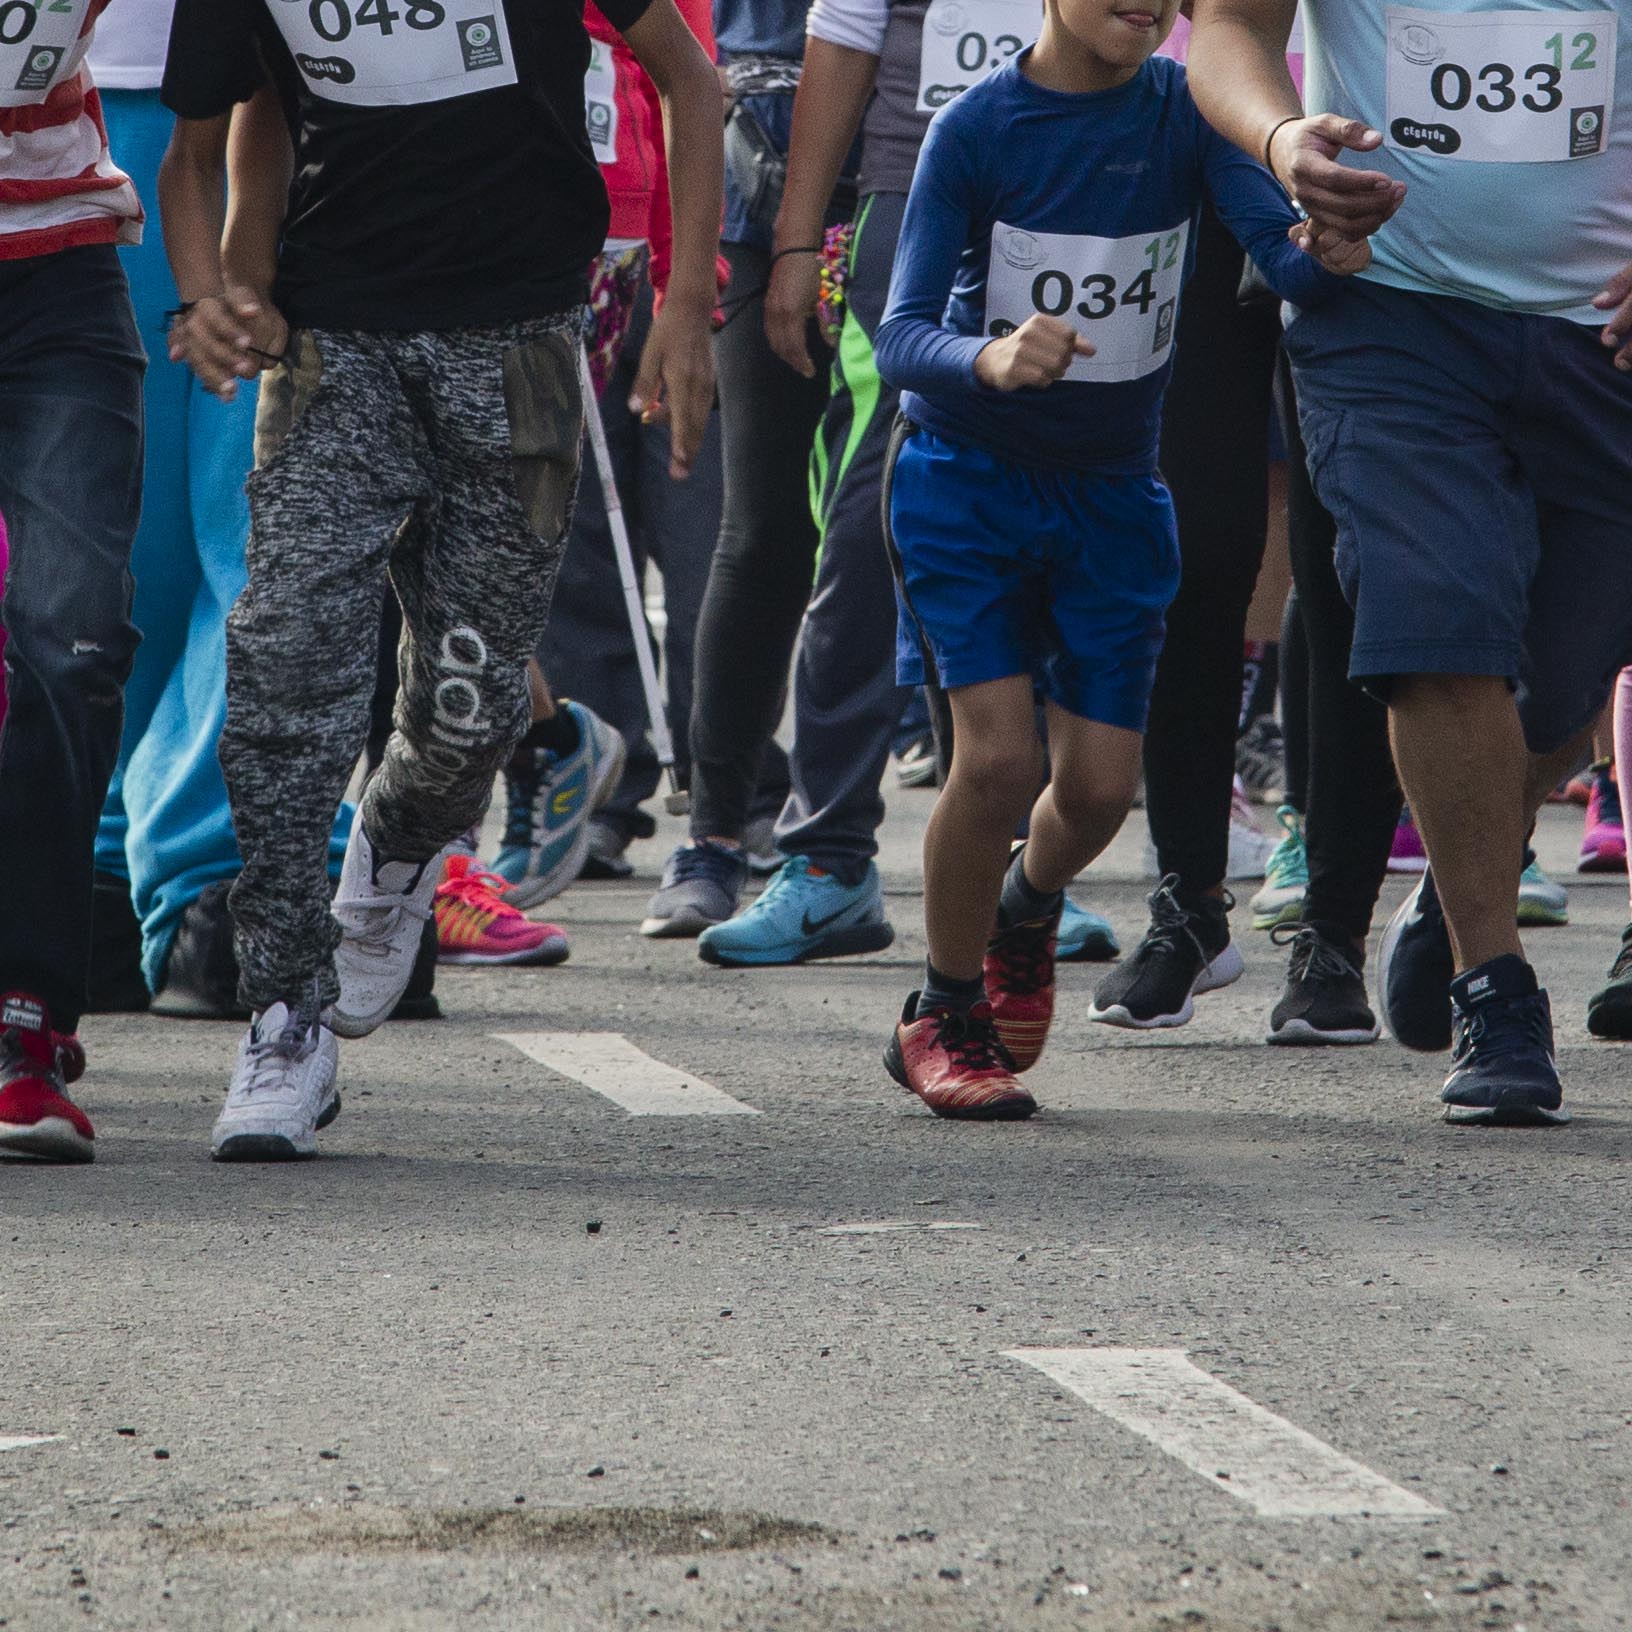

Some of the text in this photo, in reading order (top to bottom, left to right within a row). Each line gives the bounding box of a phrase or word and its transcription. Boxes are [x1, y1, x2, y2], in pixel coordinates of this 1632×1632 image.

[1544, 32, 1597, 71] 12
[1431, 62, 1563, 113] 033
[1145, 232, 1180, 273] 12
[1031, 269, 1156, 319] 034
